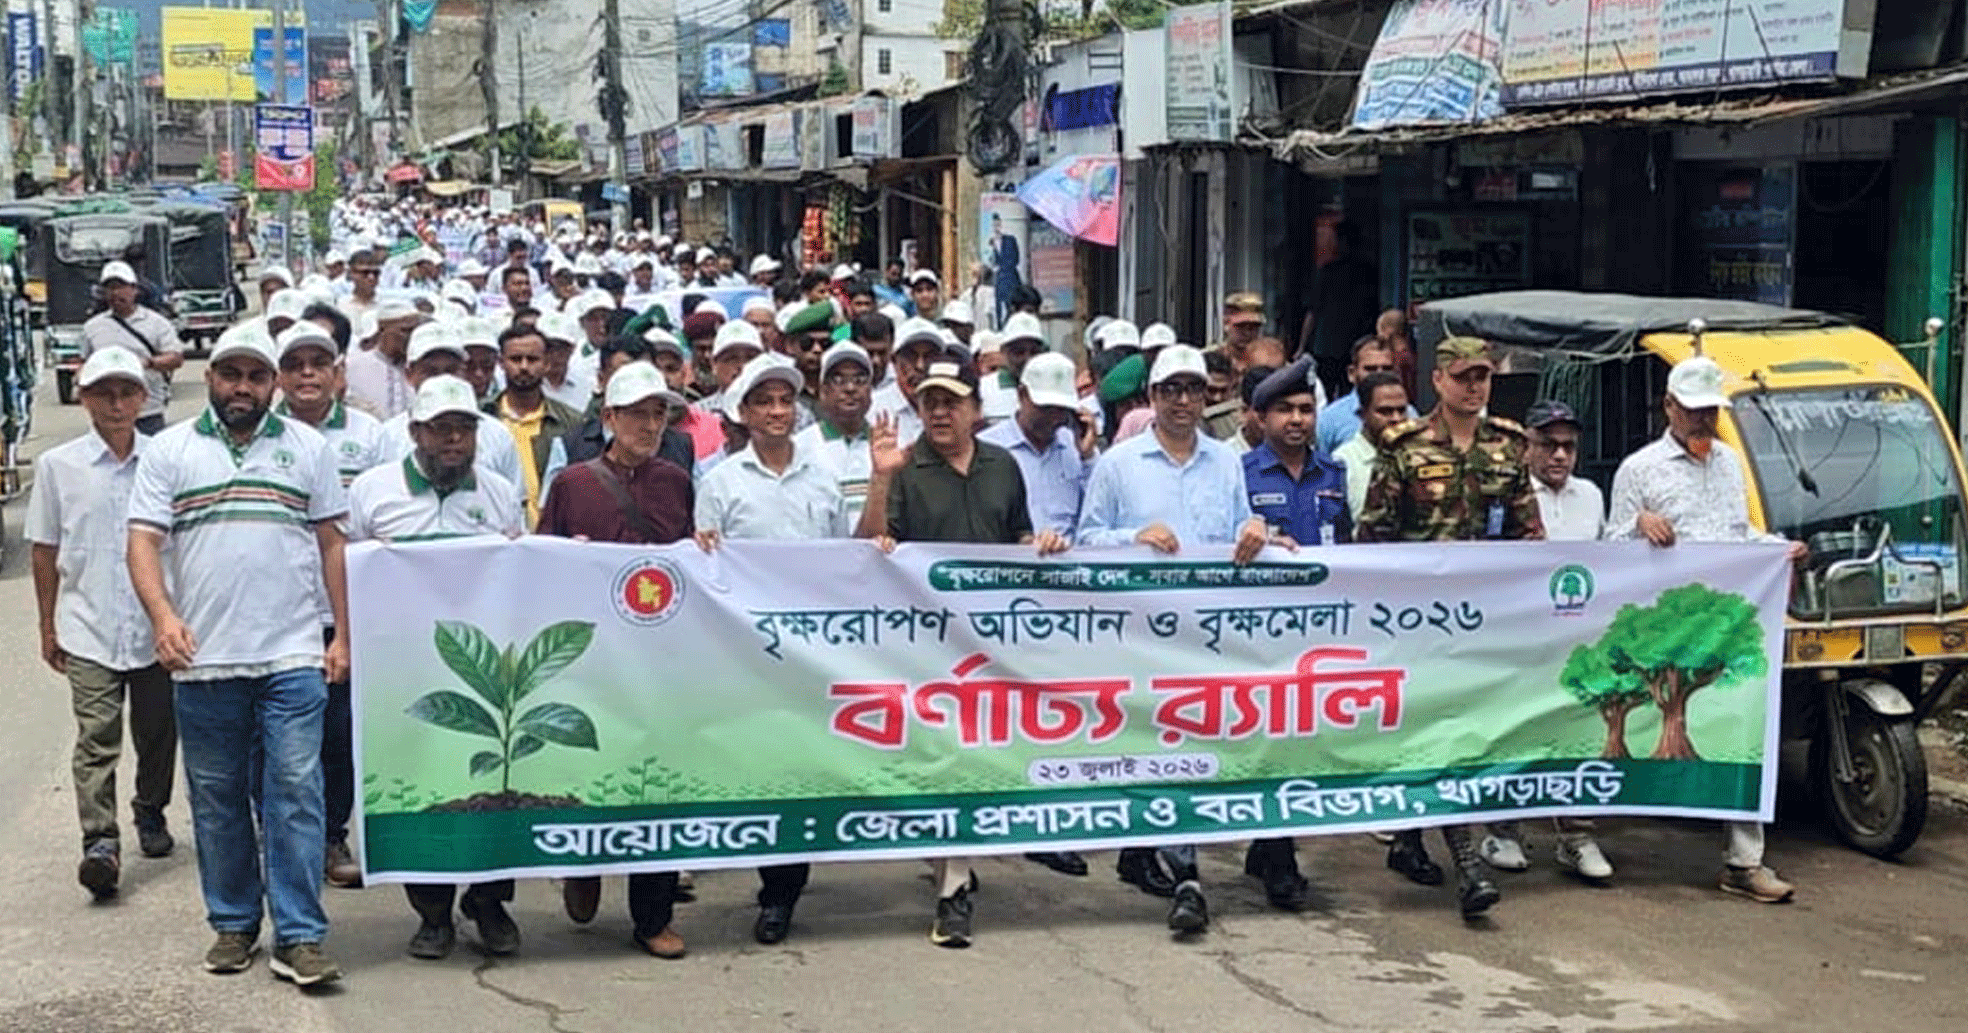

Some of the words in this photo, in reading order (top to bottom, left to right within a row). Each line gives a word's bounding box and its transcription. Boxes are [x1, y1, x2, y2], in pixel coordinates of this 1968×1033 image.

[749, 606, 953, 660] বৃক্ষরোপণ
[968, 597, 1129, 644] অভিযান
[1147, 610, 1179, 636] ও
[1195, 600, 1356, 655] বৃক্ষমেলা
[1369, 600, 1484, 636] ২০২৬
[830, 652, 1131, 748] বর্ণাঢ্য
[1037, 766, 1070, 782] ২৩
[1078, 756, 1140, 782] জুলাই
[1147, 760, 1210, 778] ২০২৬
[532, 814, 782, 857] আয়োজনে
[836, 806, 960, 844] জেলা
[972, 798, 1132, 837] প্রশাসন
[1143, 798, 1177, 827] ও
[1191, 796, 1265, 823] বন
[1278, 780, 1427, 822] বিভাগ,
[1437, 762, 1624, 809] খাগড়াছড়ি
